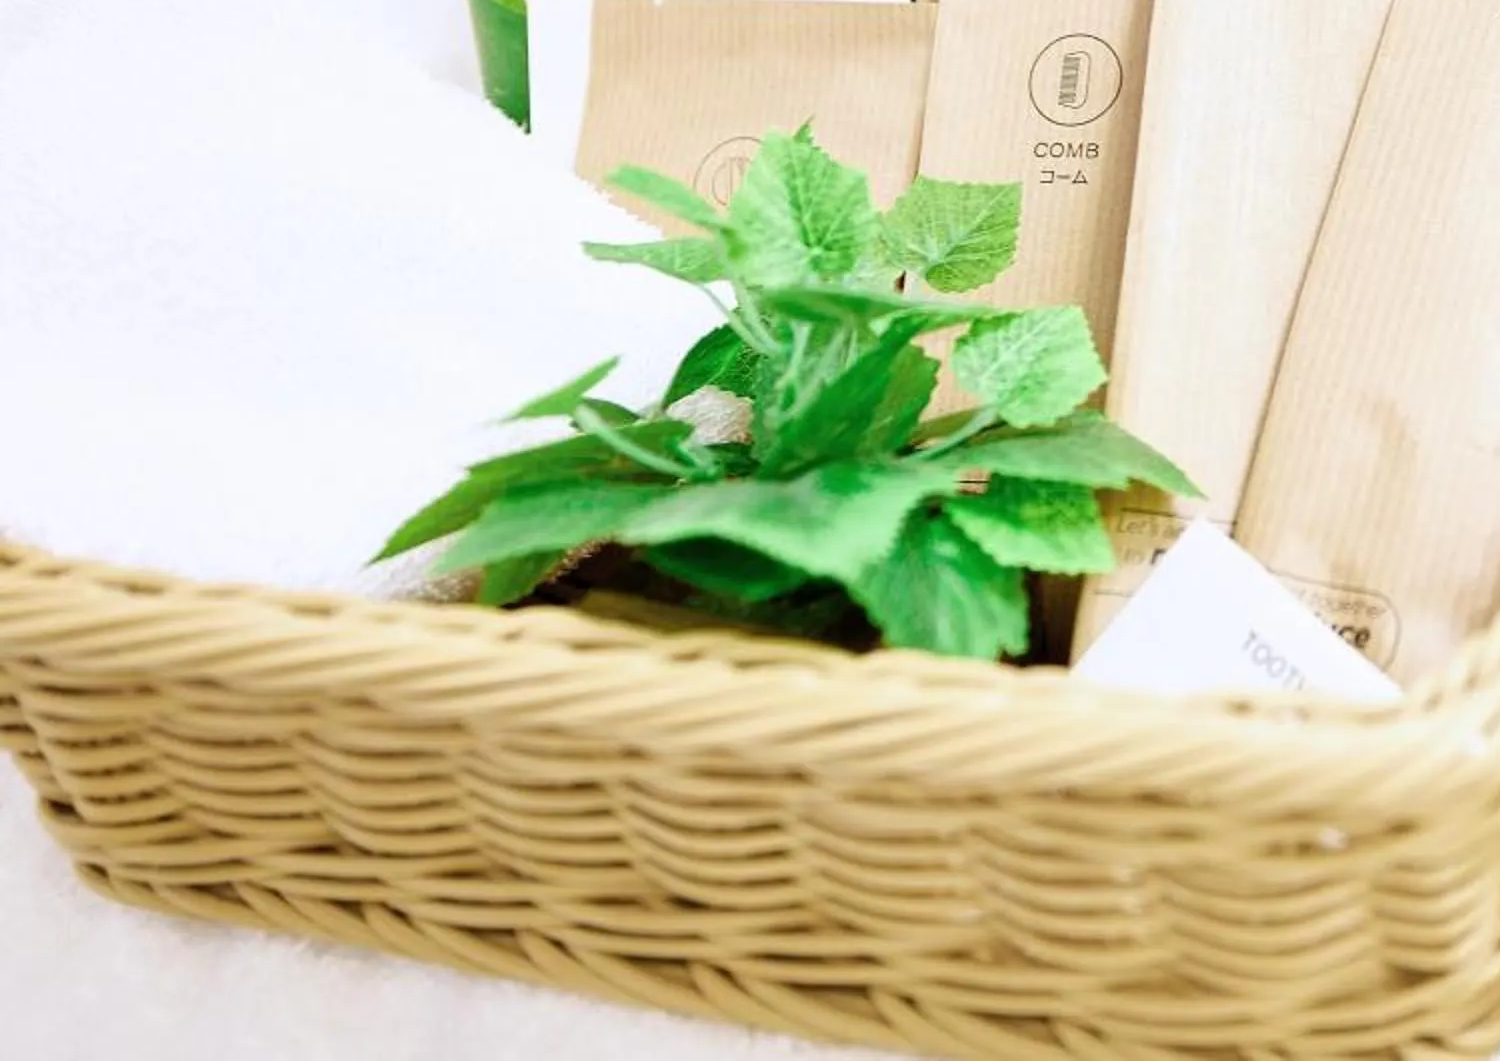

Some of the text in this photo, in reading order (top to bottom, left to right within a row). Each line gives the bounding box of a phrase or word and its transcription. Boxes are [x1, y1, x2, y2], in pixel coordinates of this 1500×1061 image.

[1033, 142, 1100, 159] COMB
[1040, 170, 1088, 184] コーム
